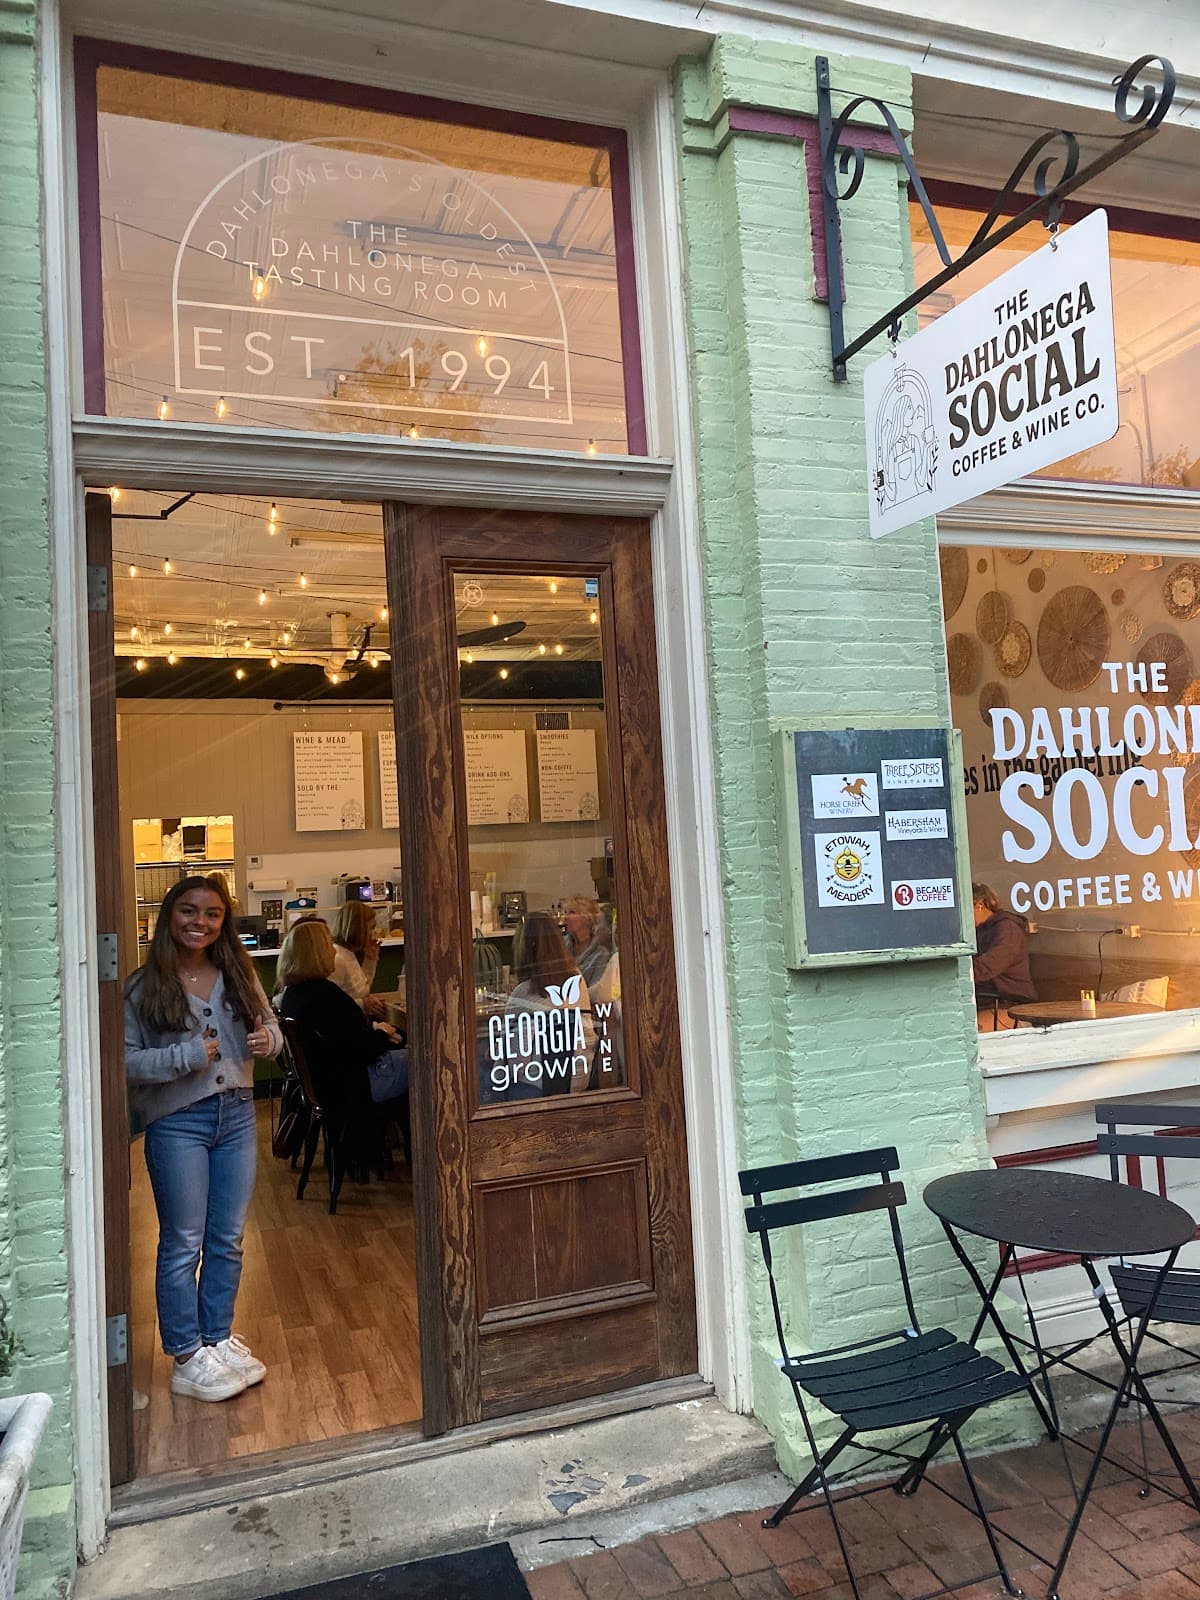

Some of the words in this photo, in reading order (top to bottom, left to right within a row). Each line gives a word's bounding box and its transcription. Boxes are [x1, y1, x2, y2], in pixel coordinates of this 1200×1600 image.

[206, 160, 422, 259] DAHLONEGA'S
[443, 193, 537, 292] OLDEST
[346, 220, 408, 246] THE
[271, 238, 483, 280] DAHLONEGA
[243, 261, 392, 296] TASTING
[414, 281, 507, 309] ROOM
[994, 289, 1028, 325] THE
[945, 281, 1095, 395] DAHLONEGA
[193, 326, 347, 382] EST.
[399, 347, 555, 400] 1994
[949, 326, 1101, 450] SOCIAL
[952, 436, 1006, 477] COFFEE
[1012, 431, 1023, 450] &
[1025, 406, 1070, 443] WINE
[1075, 393, 1105, 420] CO.
[1102, 662, 1169, 693] THE
[296, 736, 314, 744] WINE
[326, 736, 346, 744] MEAD
[884, 764, 908, 778] THREE
[910, 762, 940, 778] SISTERS
[982, 754, 1001, 793] in
[820, 801, 841, 809] HORSE
[843, 800, 862, 808] CREEK
[888, 817, 941, 829] HABERSHAM
[1000, 766, 1200, 864] SOCI
[825, 835, 871, 853] ETOWAH
[826, 884, 874, 902] MEADERY
[916, 885, 951, 895] BECAUSE
[917, 893, 947, 902] COFFEE
[1011, 874, 1132, 913] COFFEE
[1142, 872, 1163, 903] &
[488, 1006, 586, 1061] GEORGIA
[595, 1002, 613, 1073] WINE
[490, 1054, 588, 1092] grown
